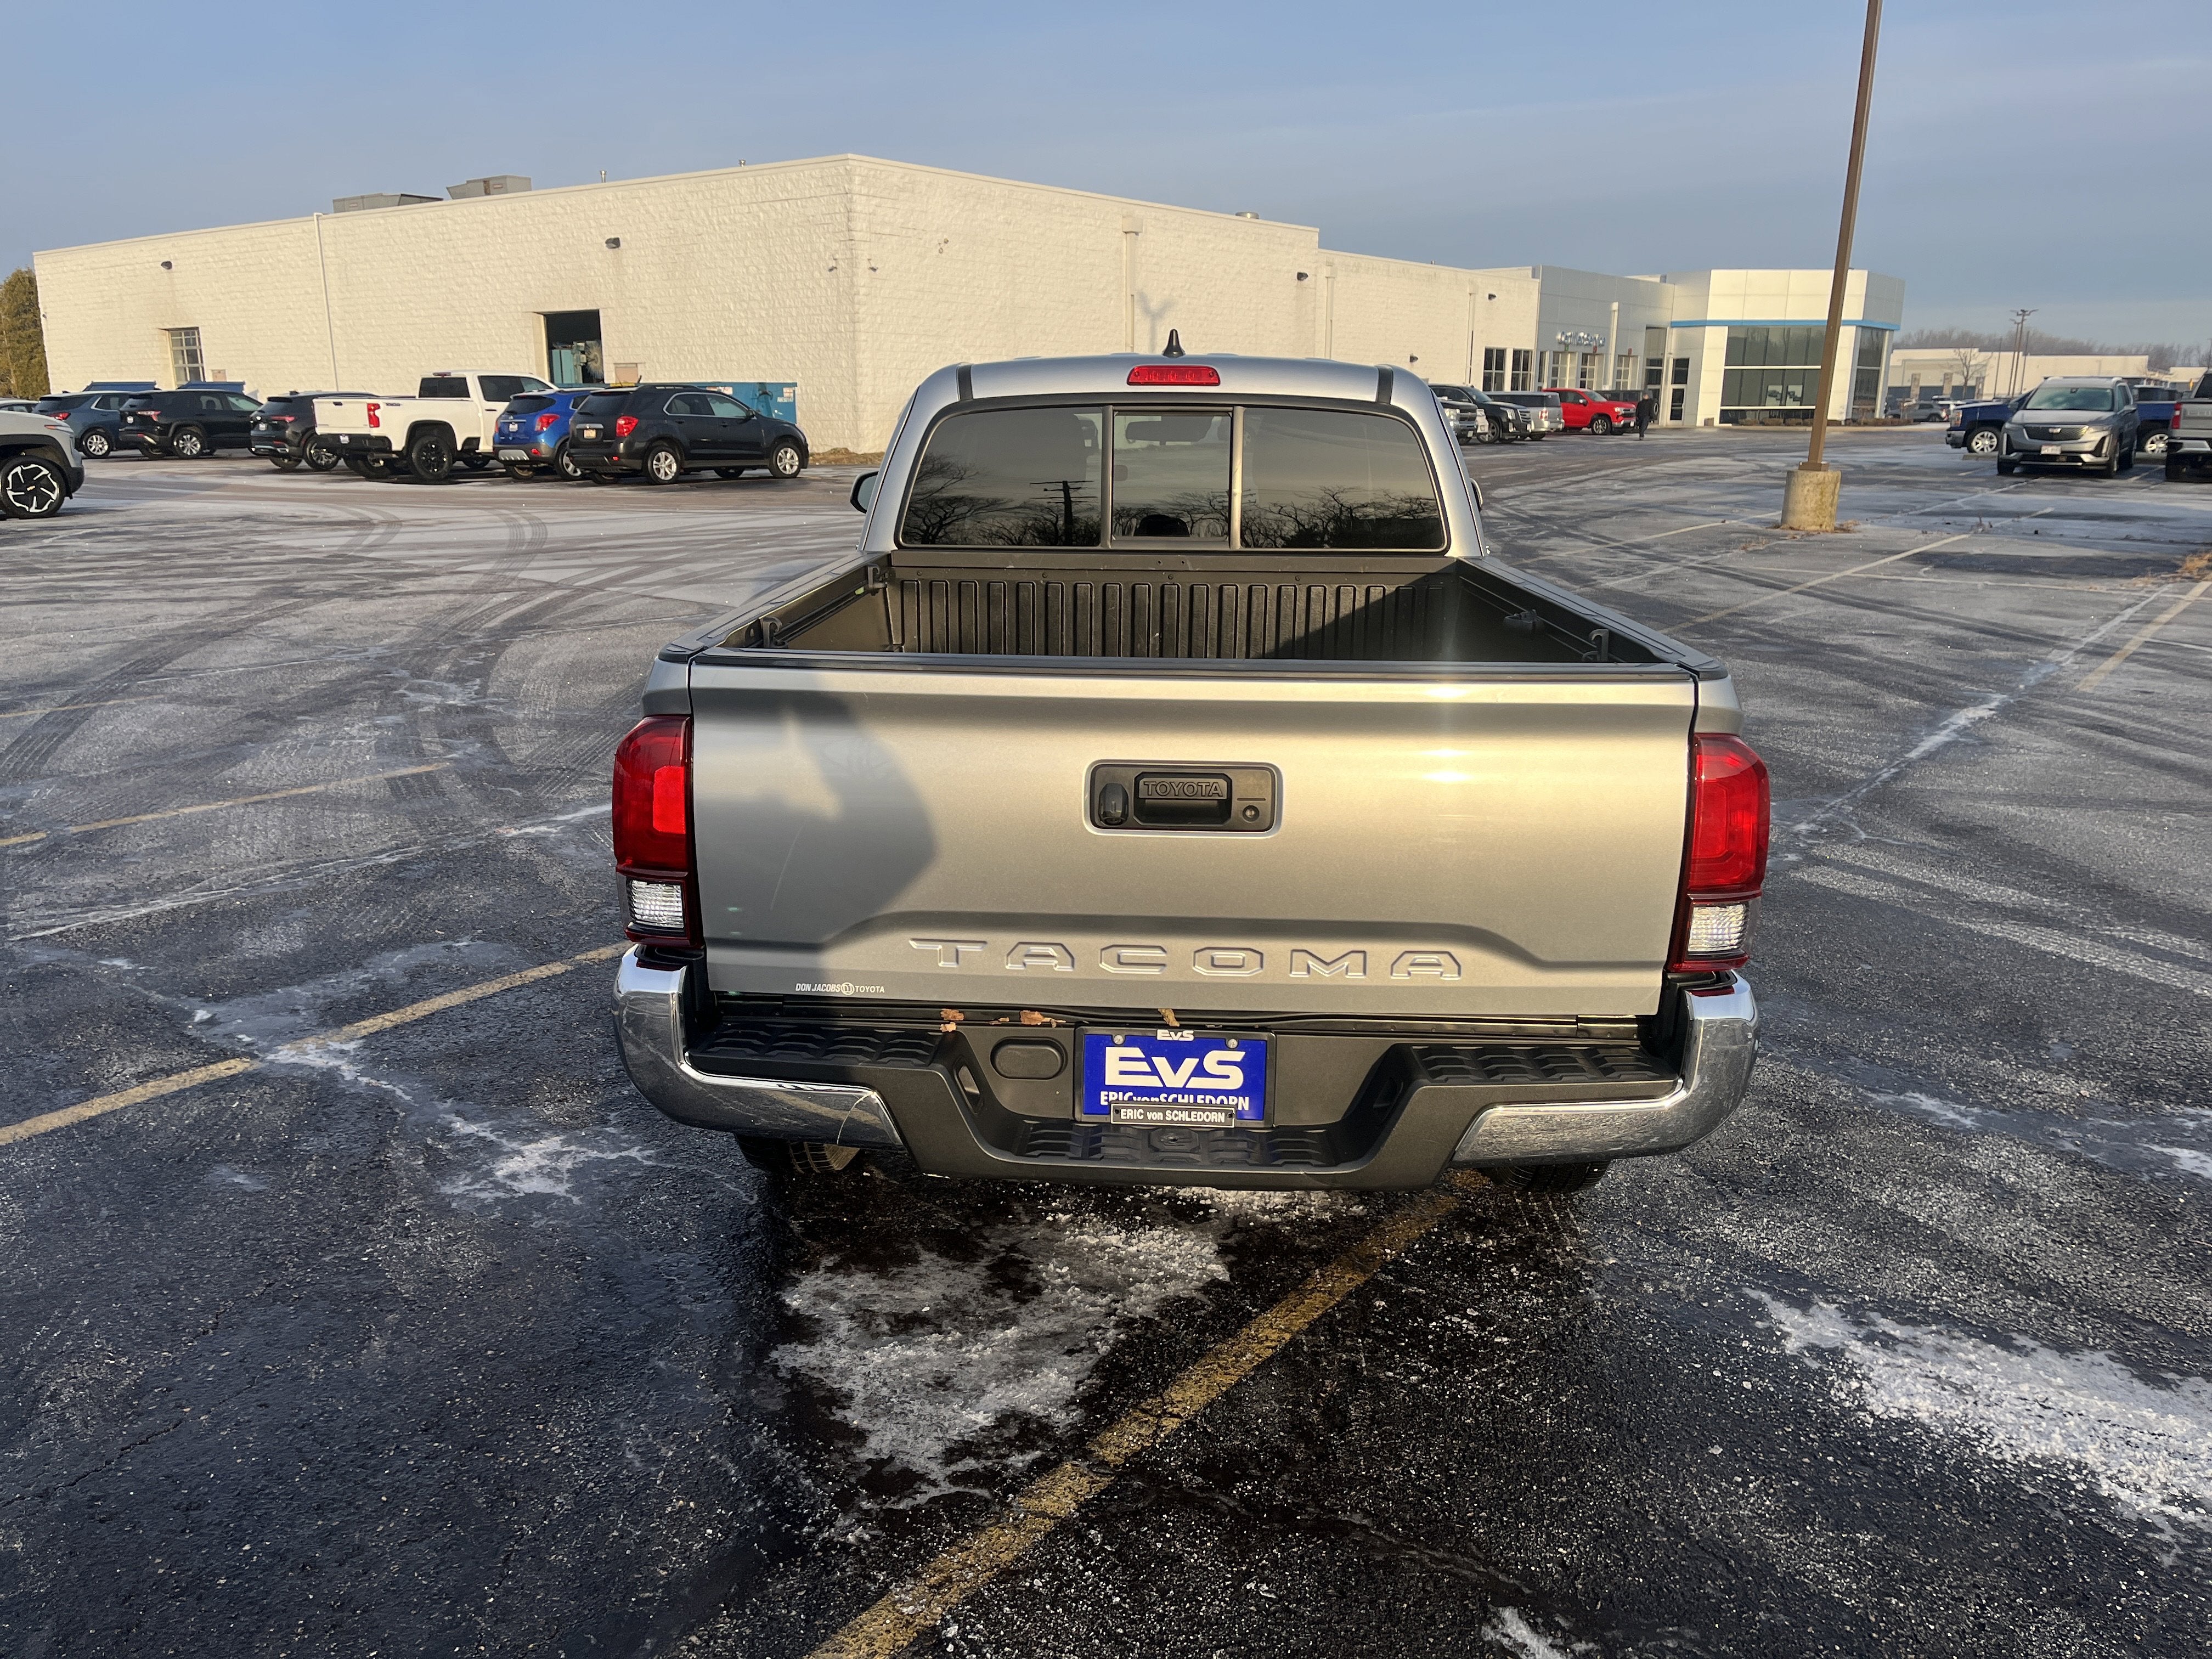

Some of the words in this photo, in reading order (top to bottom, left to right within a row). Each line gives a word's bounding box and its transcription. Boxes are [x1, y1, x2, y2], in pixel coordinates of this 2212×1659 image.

[1144, 781, 1223, 797] TOYOTA
[909, 938, 1463, 980] TACOMA
[795, 983, 811, 991] DON
[812, 984, 841, 992] JACOBS
[1105, 1046, 1246, 1090] EvS
[1120, 1109, 1144, 1120] ERIC
[1146, 1111, 1163, 1120] von
[1165, 1110, 1225, 1122] SCHLEDORN
